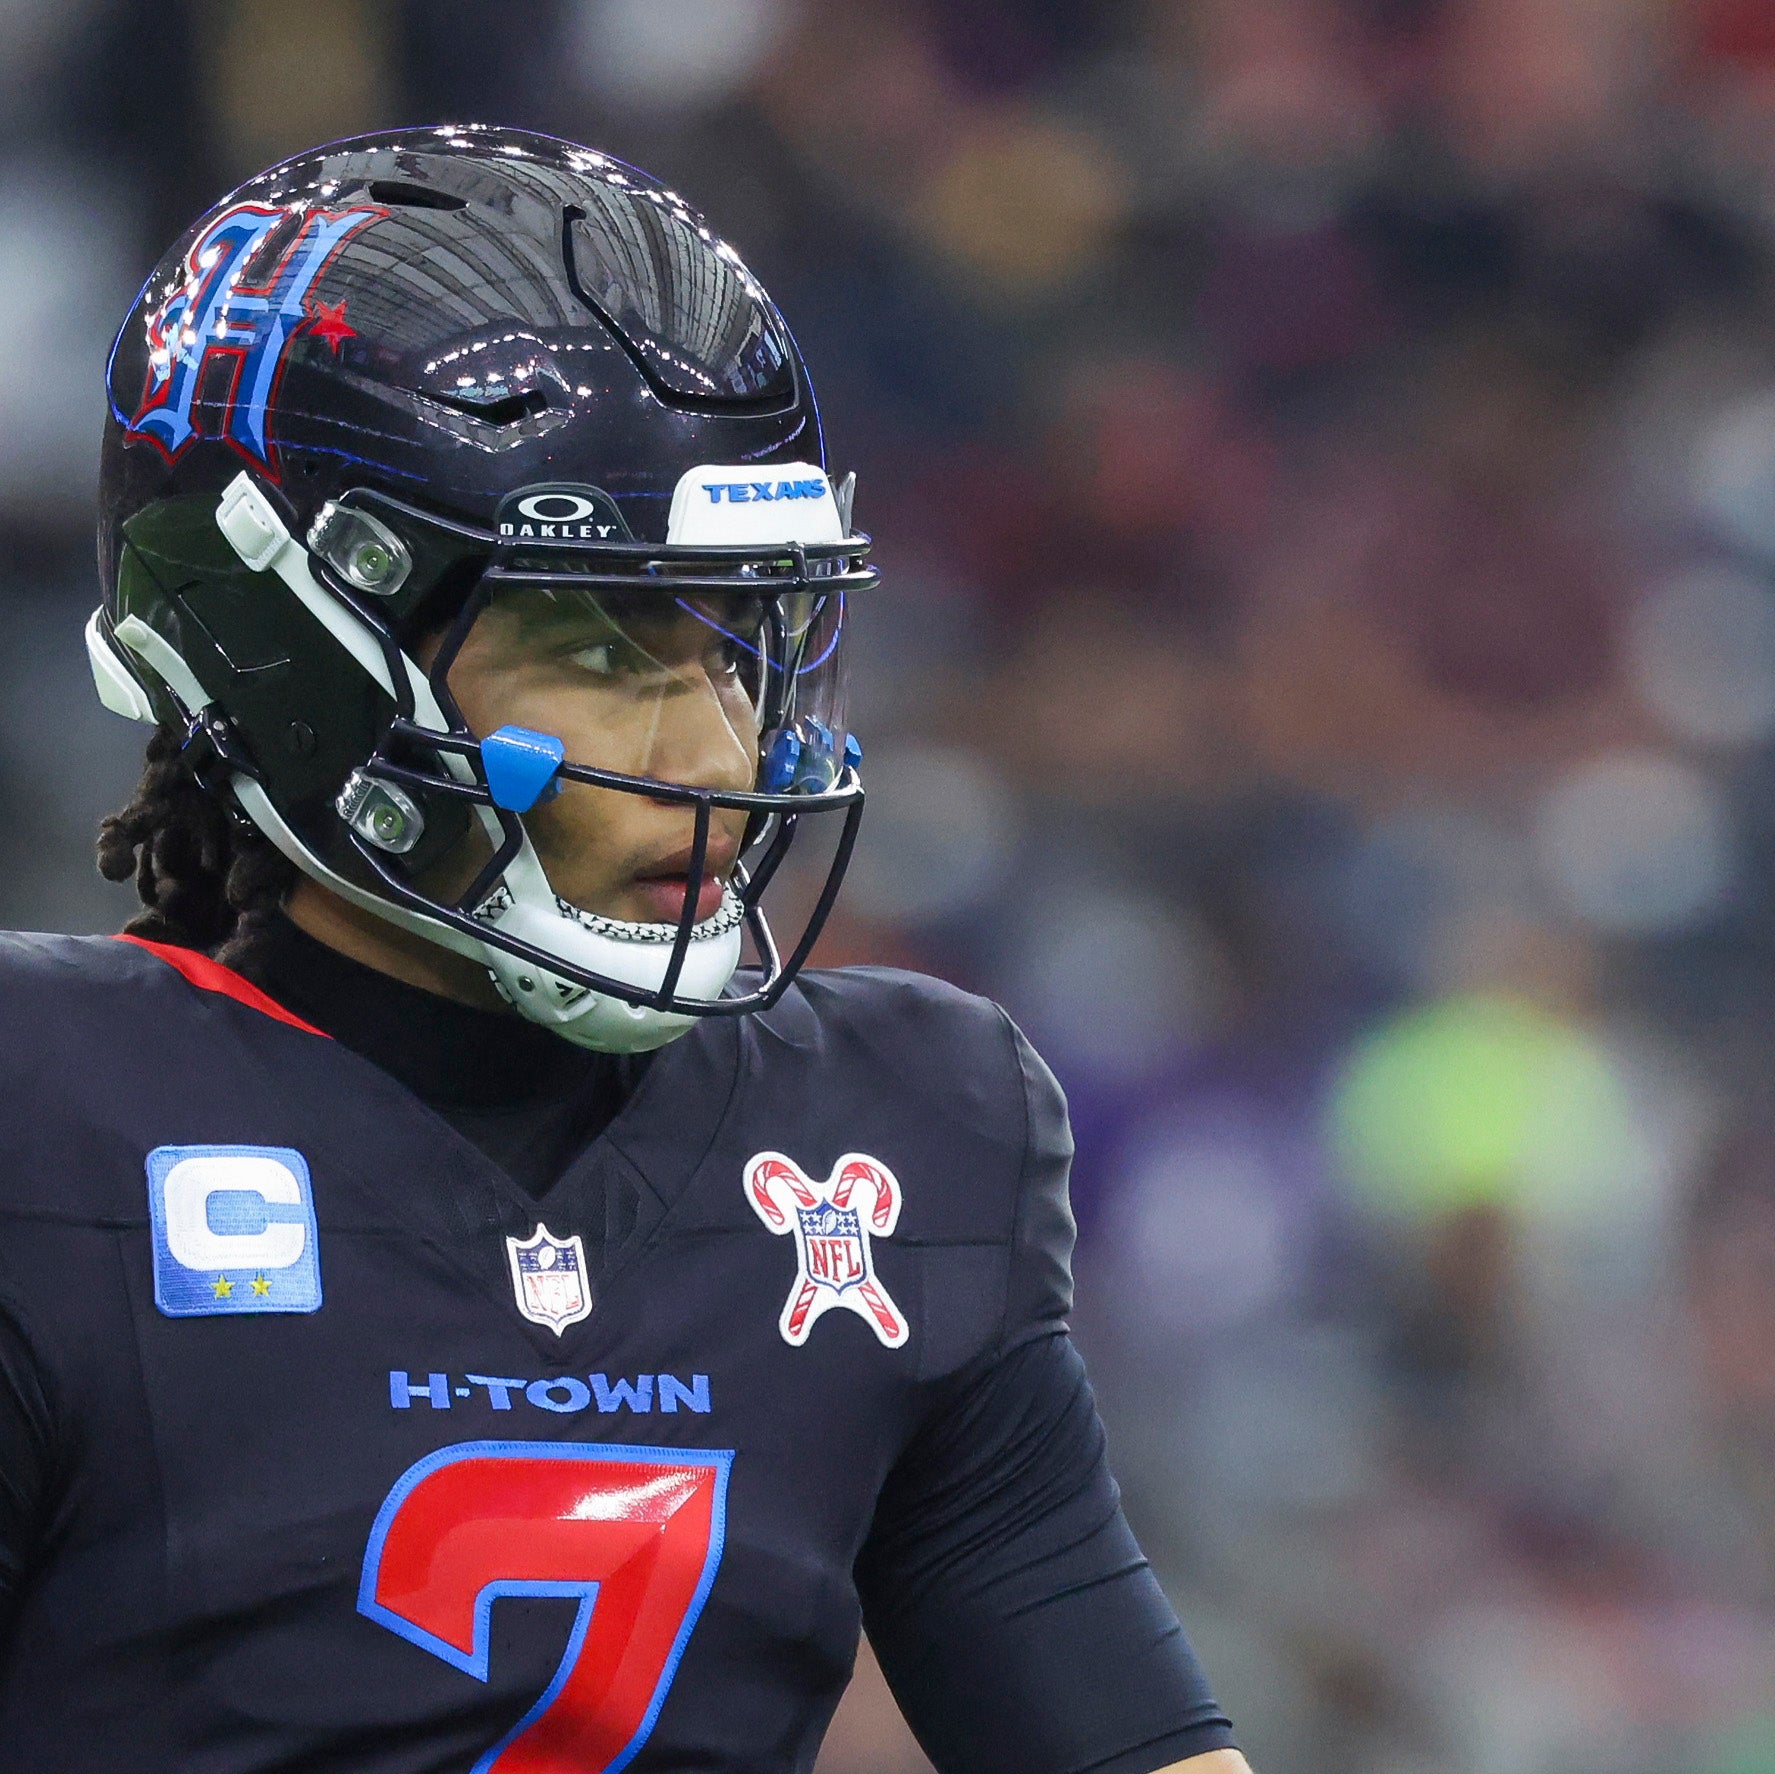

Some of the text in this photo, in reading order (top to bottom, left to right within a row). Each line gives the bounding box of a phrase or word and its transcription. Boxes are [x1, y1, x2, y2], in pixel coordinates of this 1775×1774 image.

[702, 479, 826, 503] TEXANS
[499, 523, 616, 539] OAKLEY
[163, 1156, 306, 1272] C
[809, 1239, 861, 1283] NFL
[526, 1274, 581, 1315] NFL
[389, 1370, 712, 1414] H-TOWN
